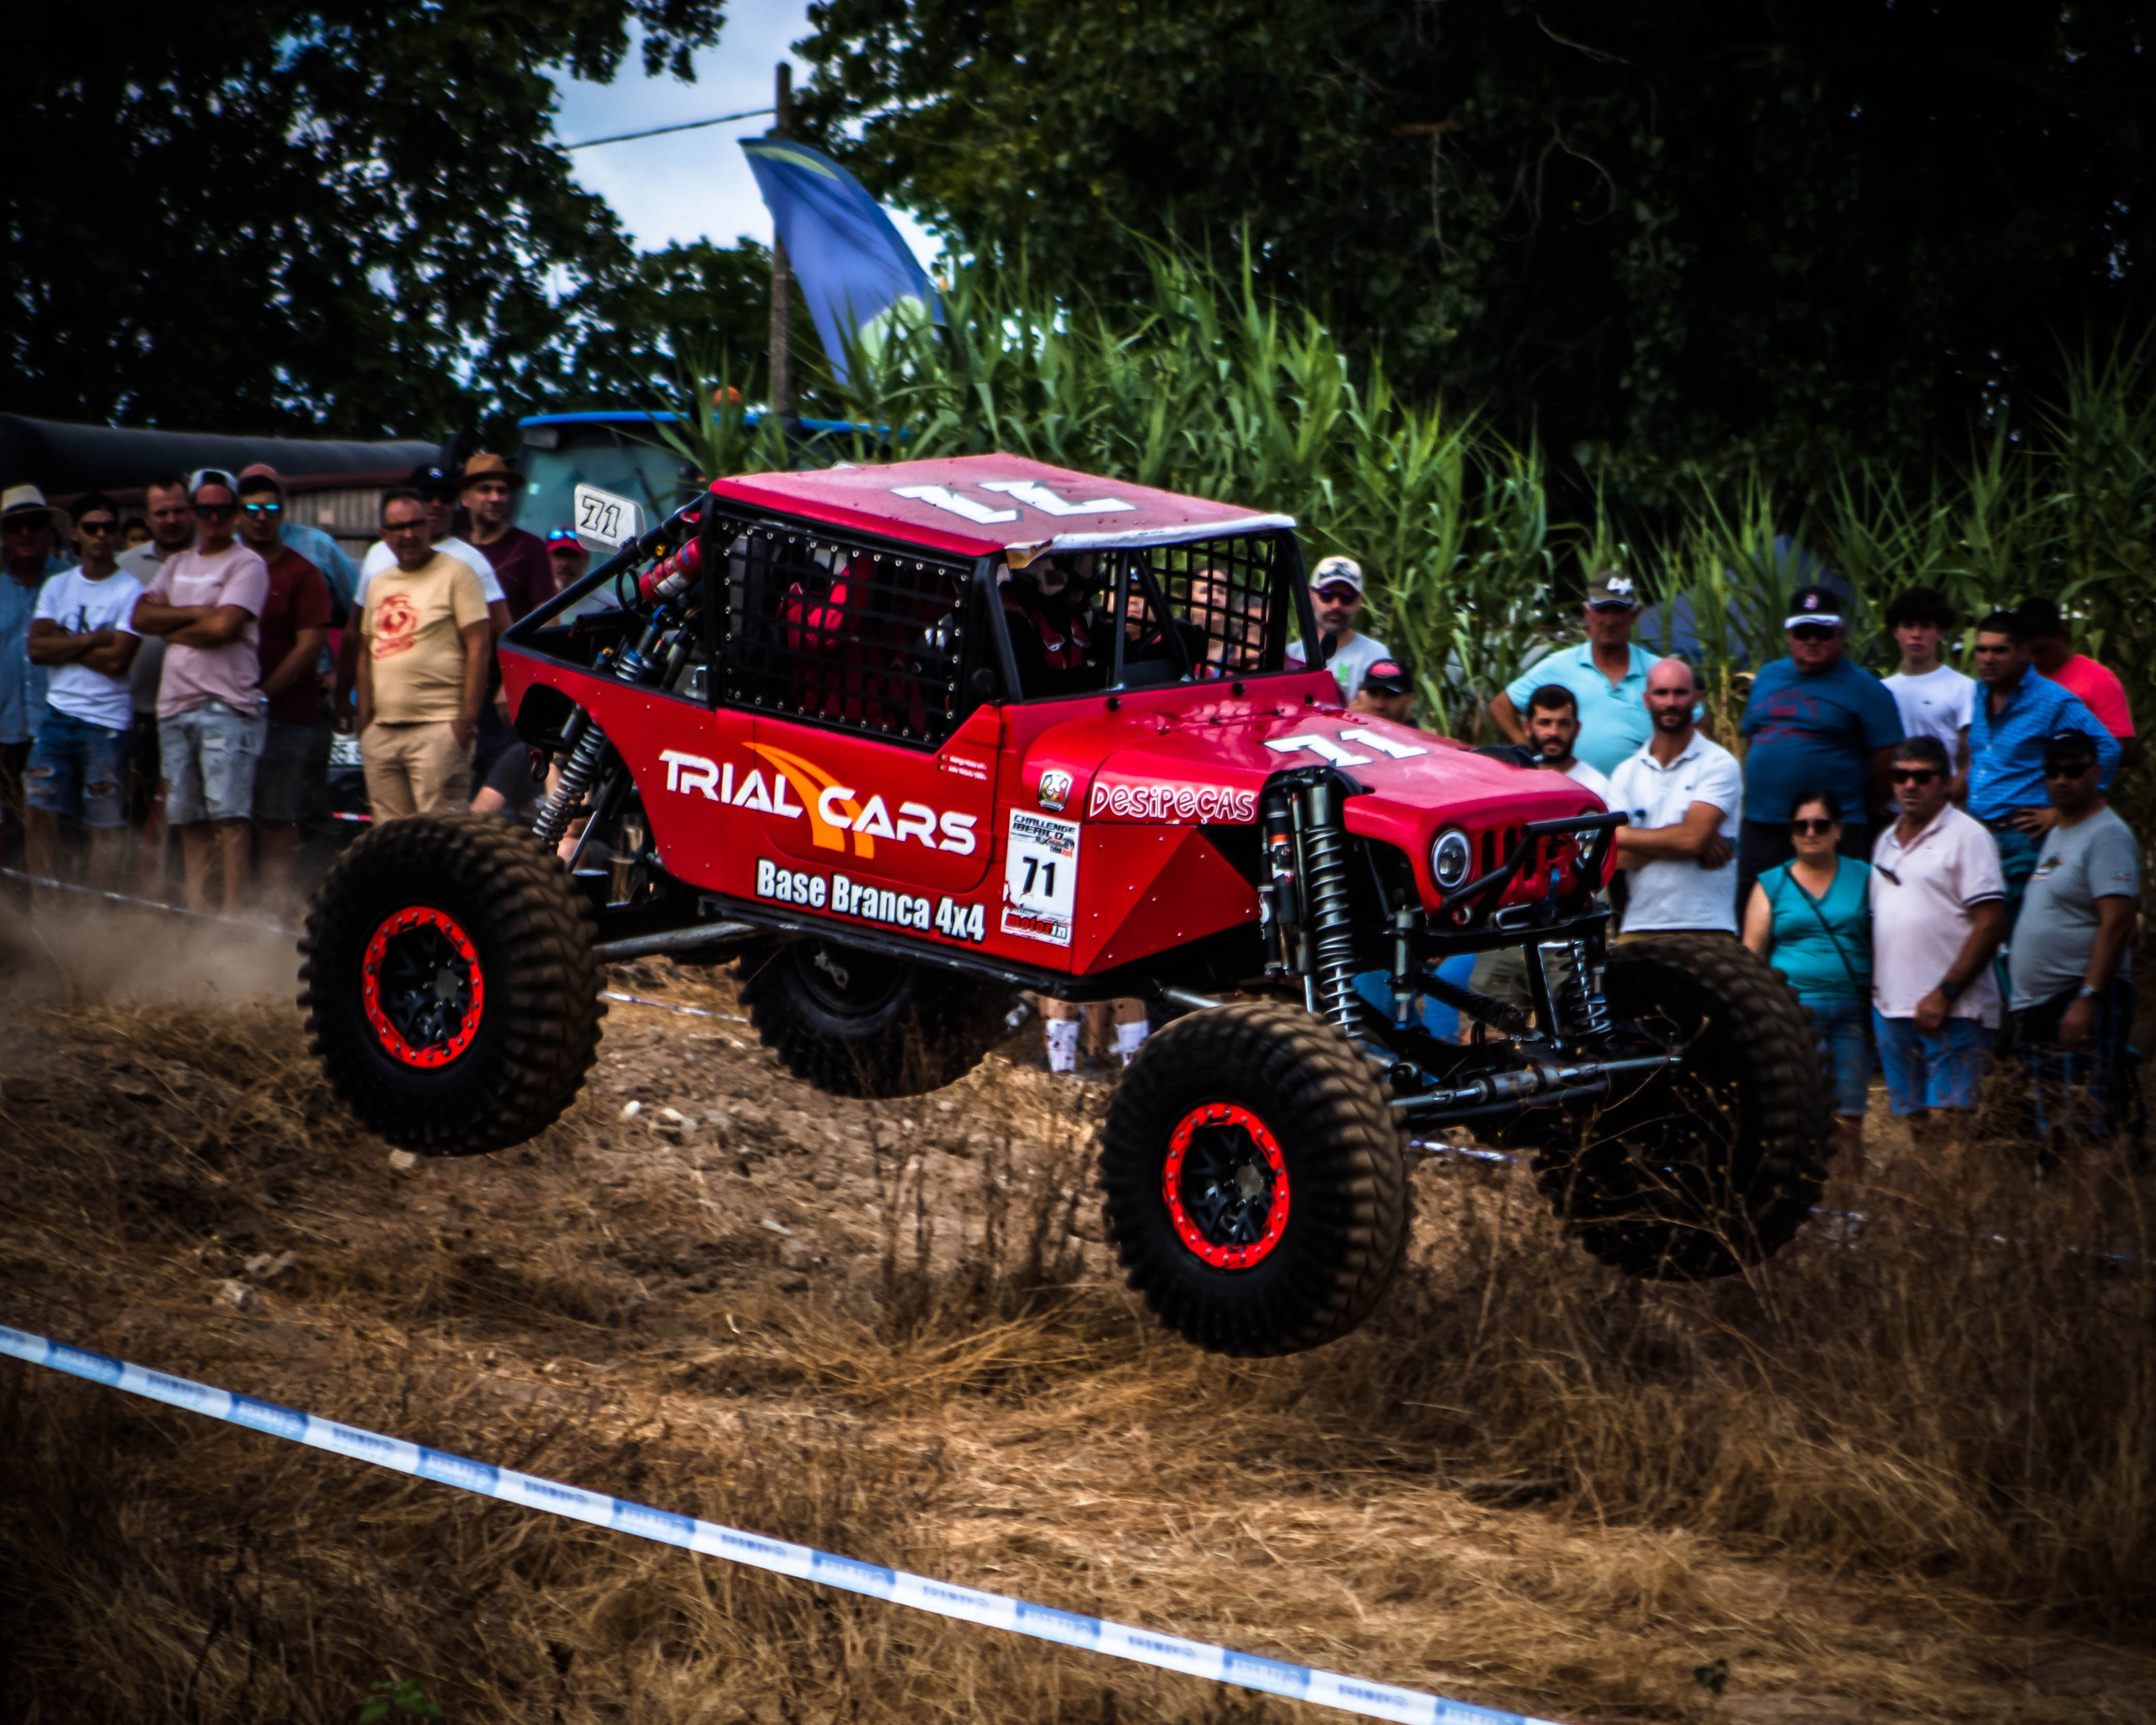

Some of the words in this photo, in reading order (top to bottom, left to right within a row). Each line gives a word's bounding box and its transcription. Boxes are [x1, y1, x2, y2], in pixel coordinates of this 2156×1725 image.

[580, 496, 621, 538] 71
[1263, 729, 1428, 767] 71
[659, 749, 803, 819] TRIAL
[818, 786, 978, 856] CARS
[1014, 814, 1075, 834] CHALLENGE
[1022, 857, 1056, 898] 71
[757, 859, 826, 908] Base
[831, 873, 930, 930] Branca
[934, 897, 986, 942] 4x4
